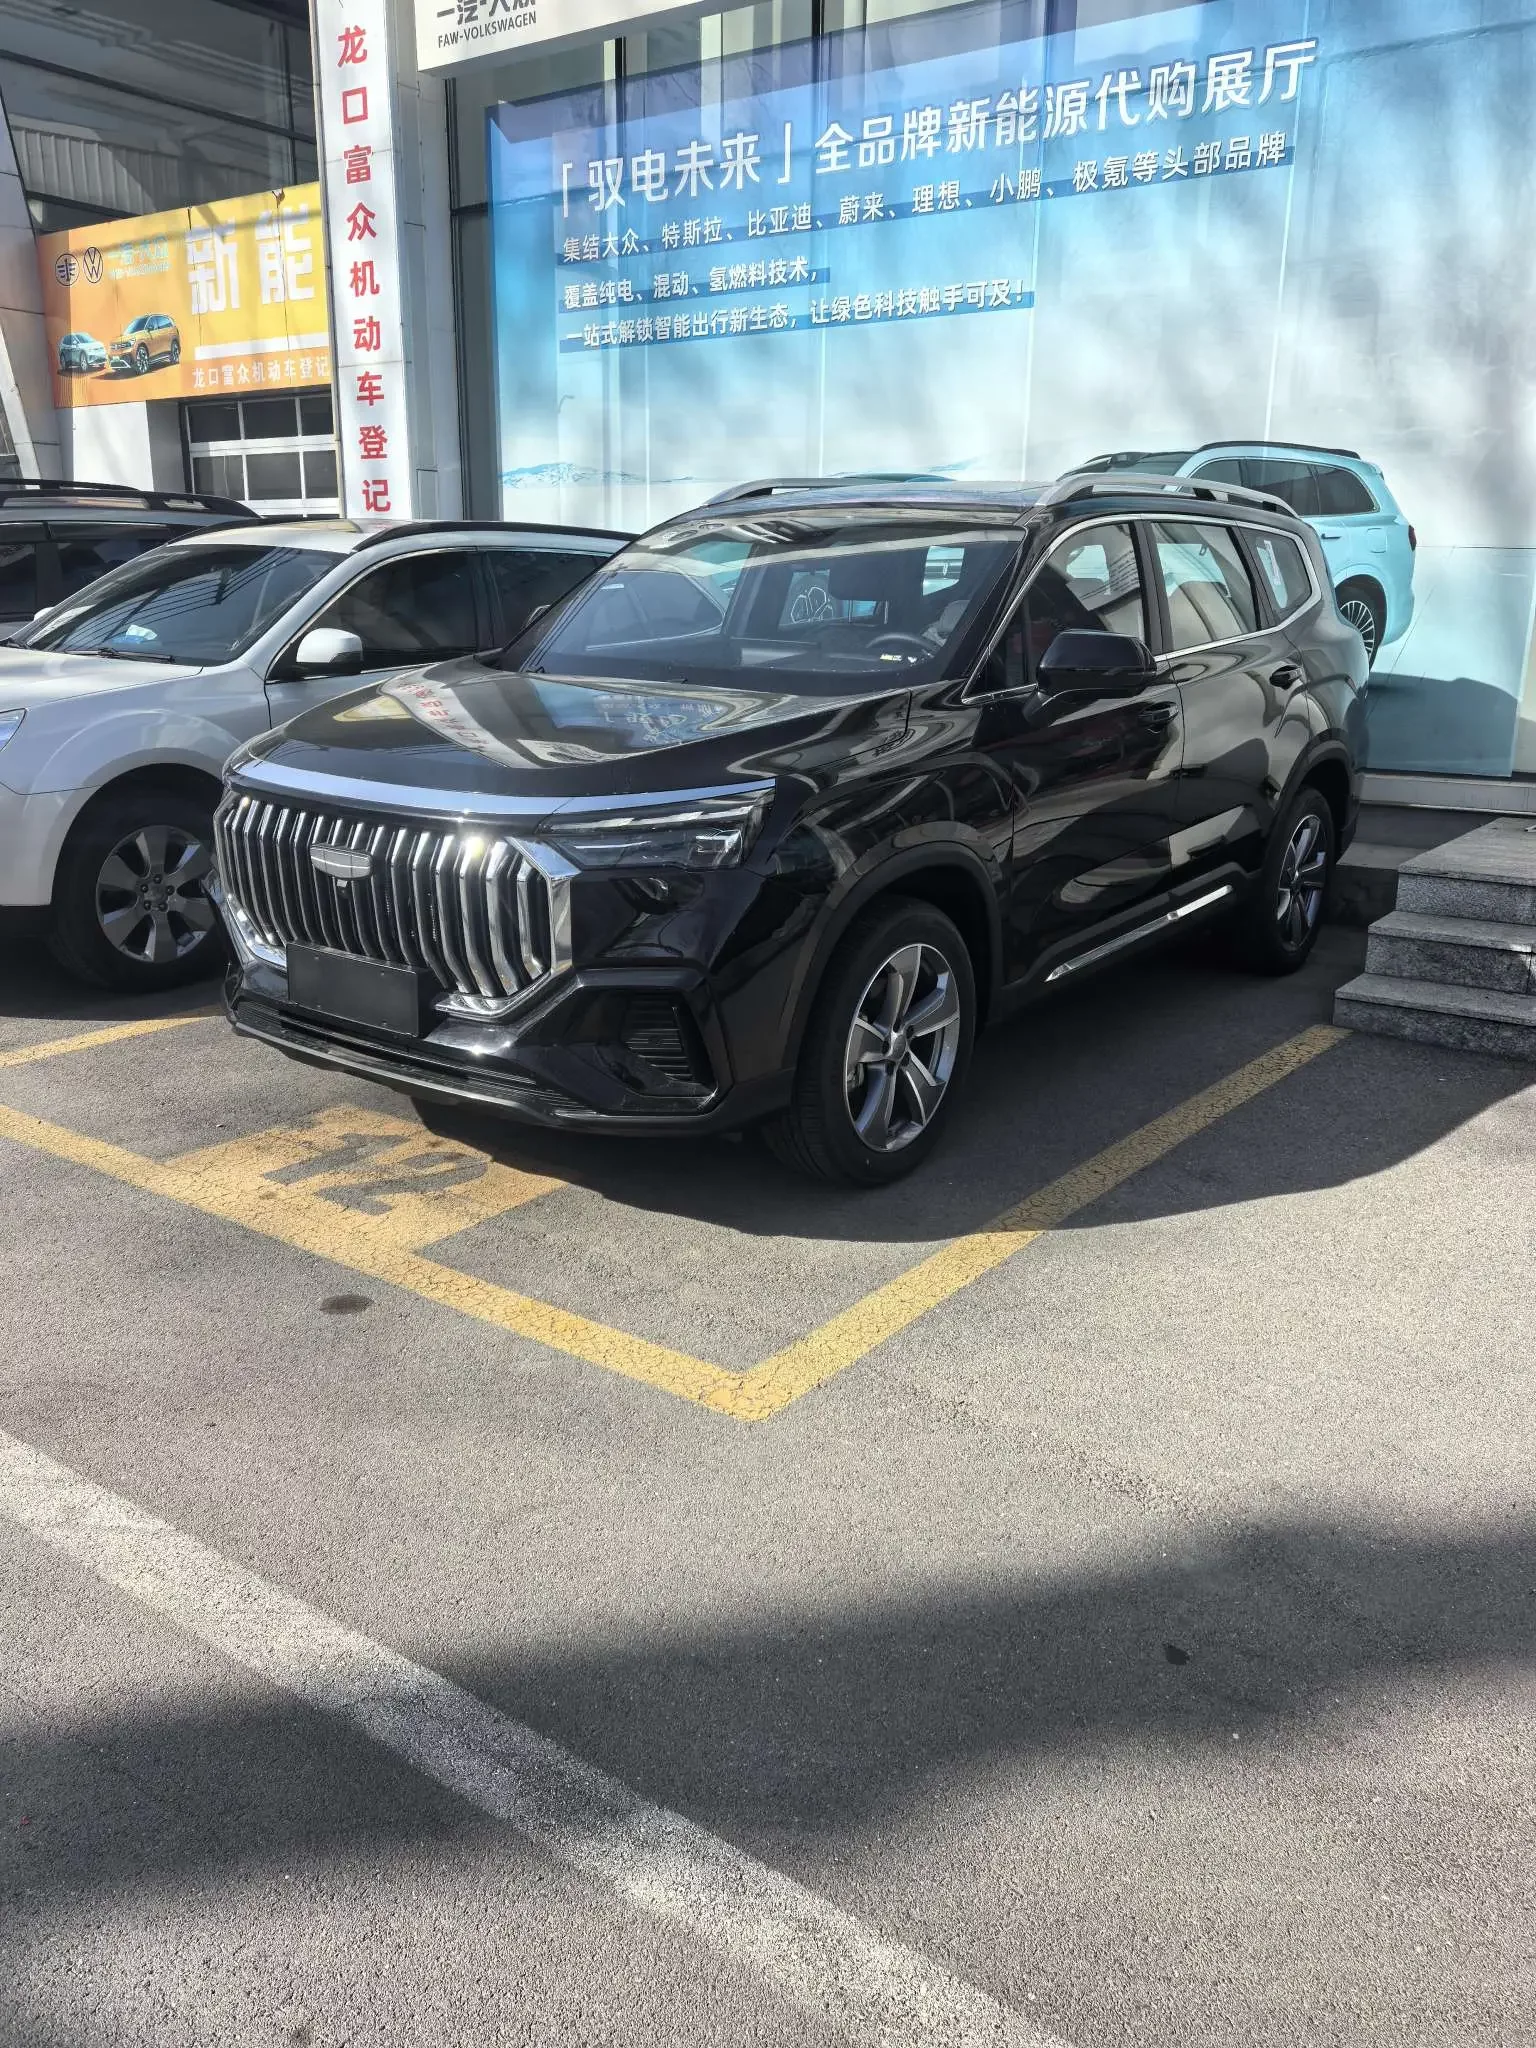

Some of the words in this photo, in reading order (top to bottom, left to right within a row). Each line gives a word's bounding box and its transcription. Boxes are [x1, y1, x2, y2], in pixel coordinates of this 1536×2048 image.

[438, 11, 537, 48] FAW-VOLKSWAGEN
[337, 25, 391, 513] 龙口富众机动车登记
